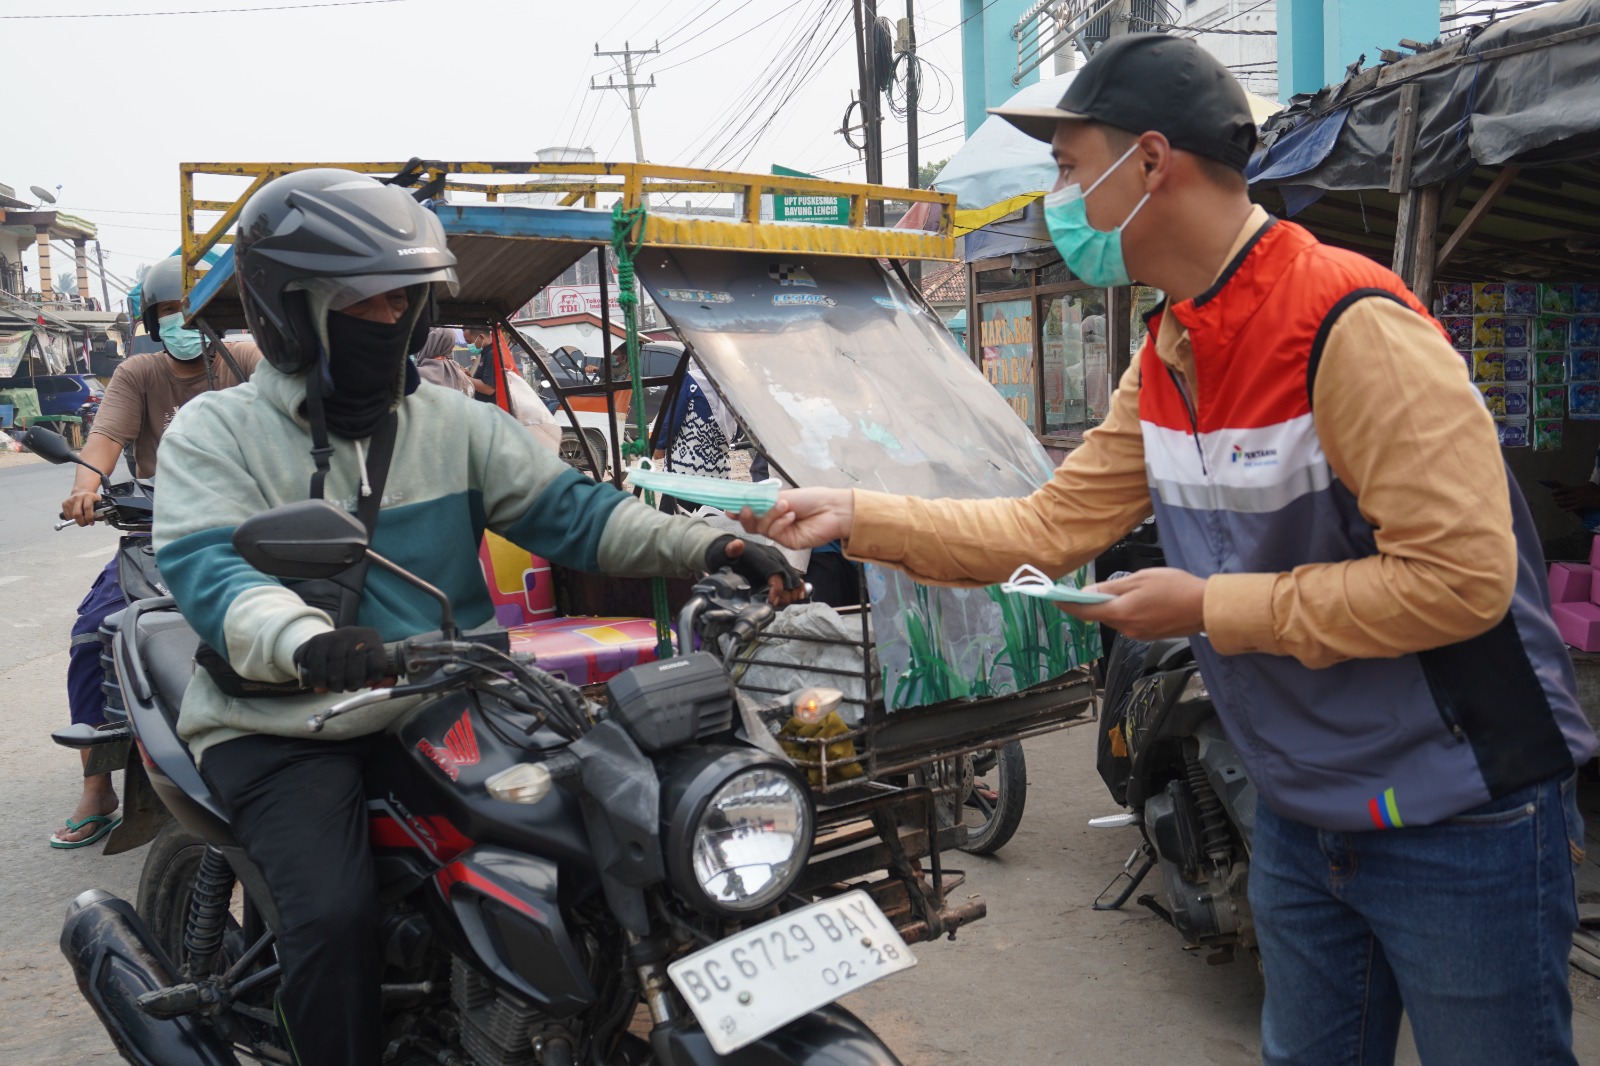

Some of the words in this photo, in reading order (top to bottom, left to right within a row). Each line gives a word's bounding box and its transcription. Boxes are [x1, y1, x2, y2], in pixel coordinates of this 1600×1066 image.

[784, 197, 797, 206] UPT
[798, 196, 838, 206] PUSKESMAS
[784, 206, 812, 216] BAYUNG
[813, 206, 838, 216] LENCIR
[559, 305, 578, 313] TDI
[681, 959, 731, 1004] BG
[730, 923, 816, 979] 6729
[814, 900, 877, 943] BAY
